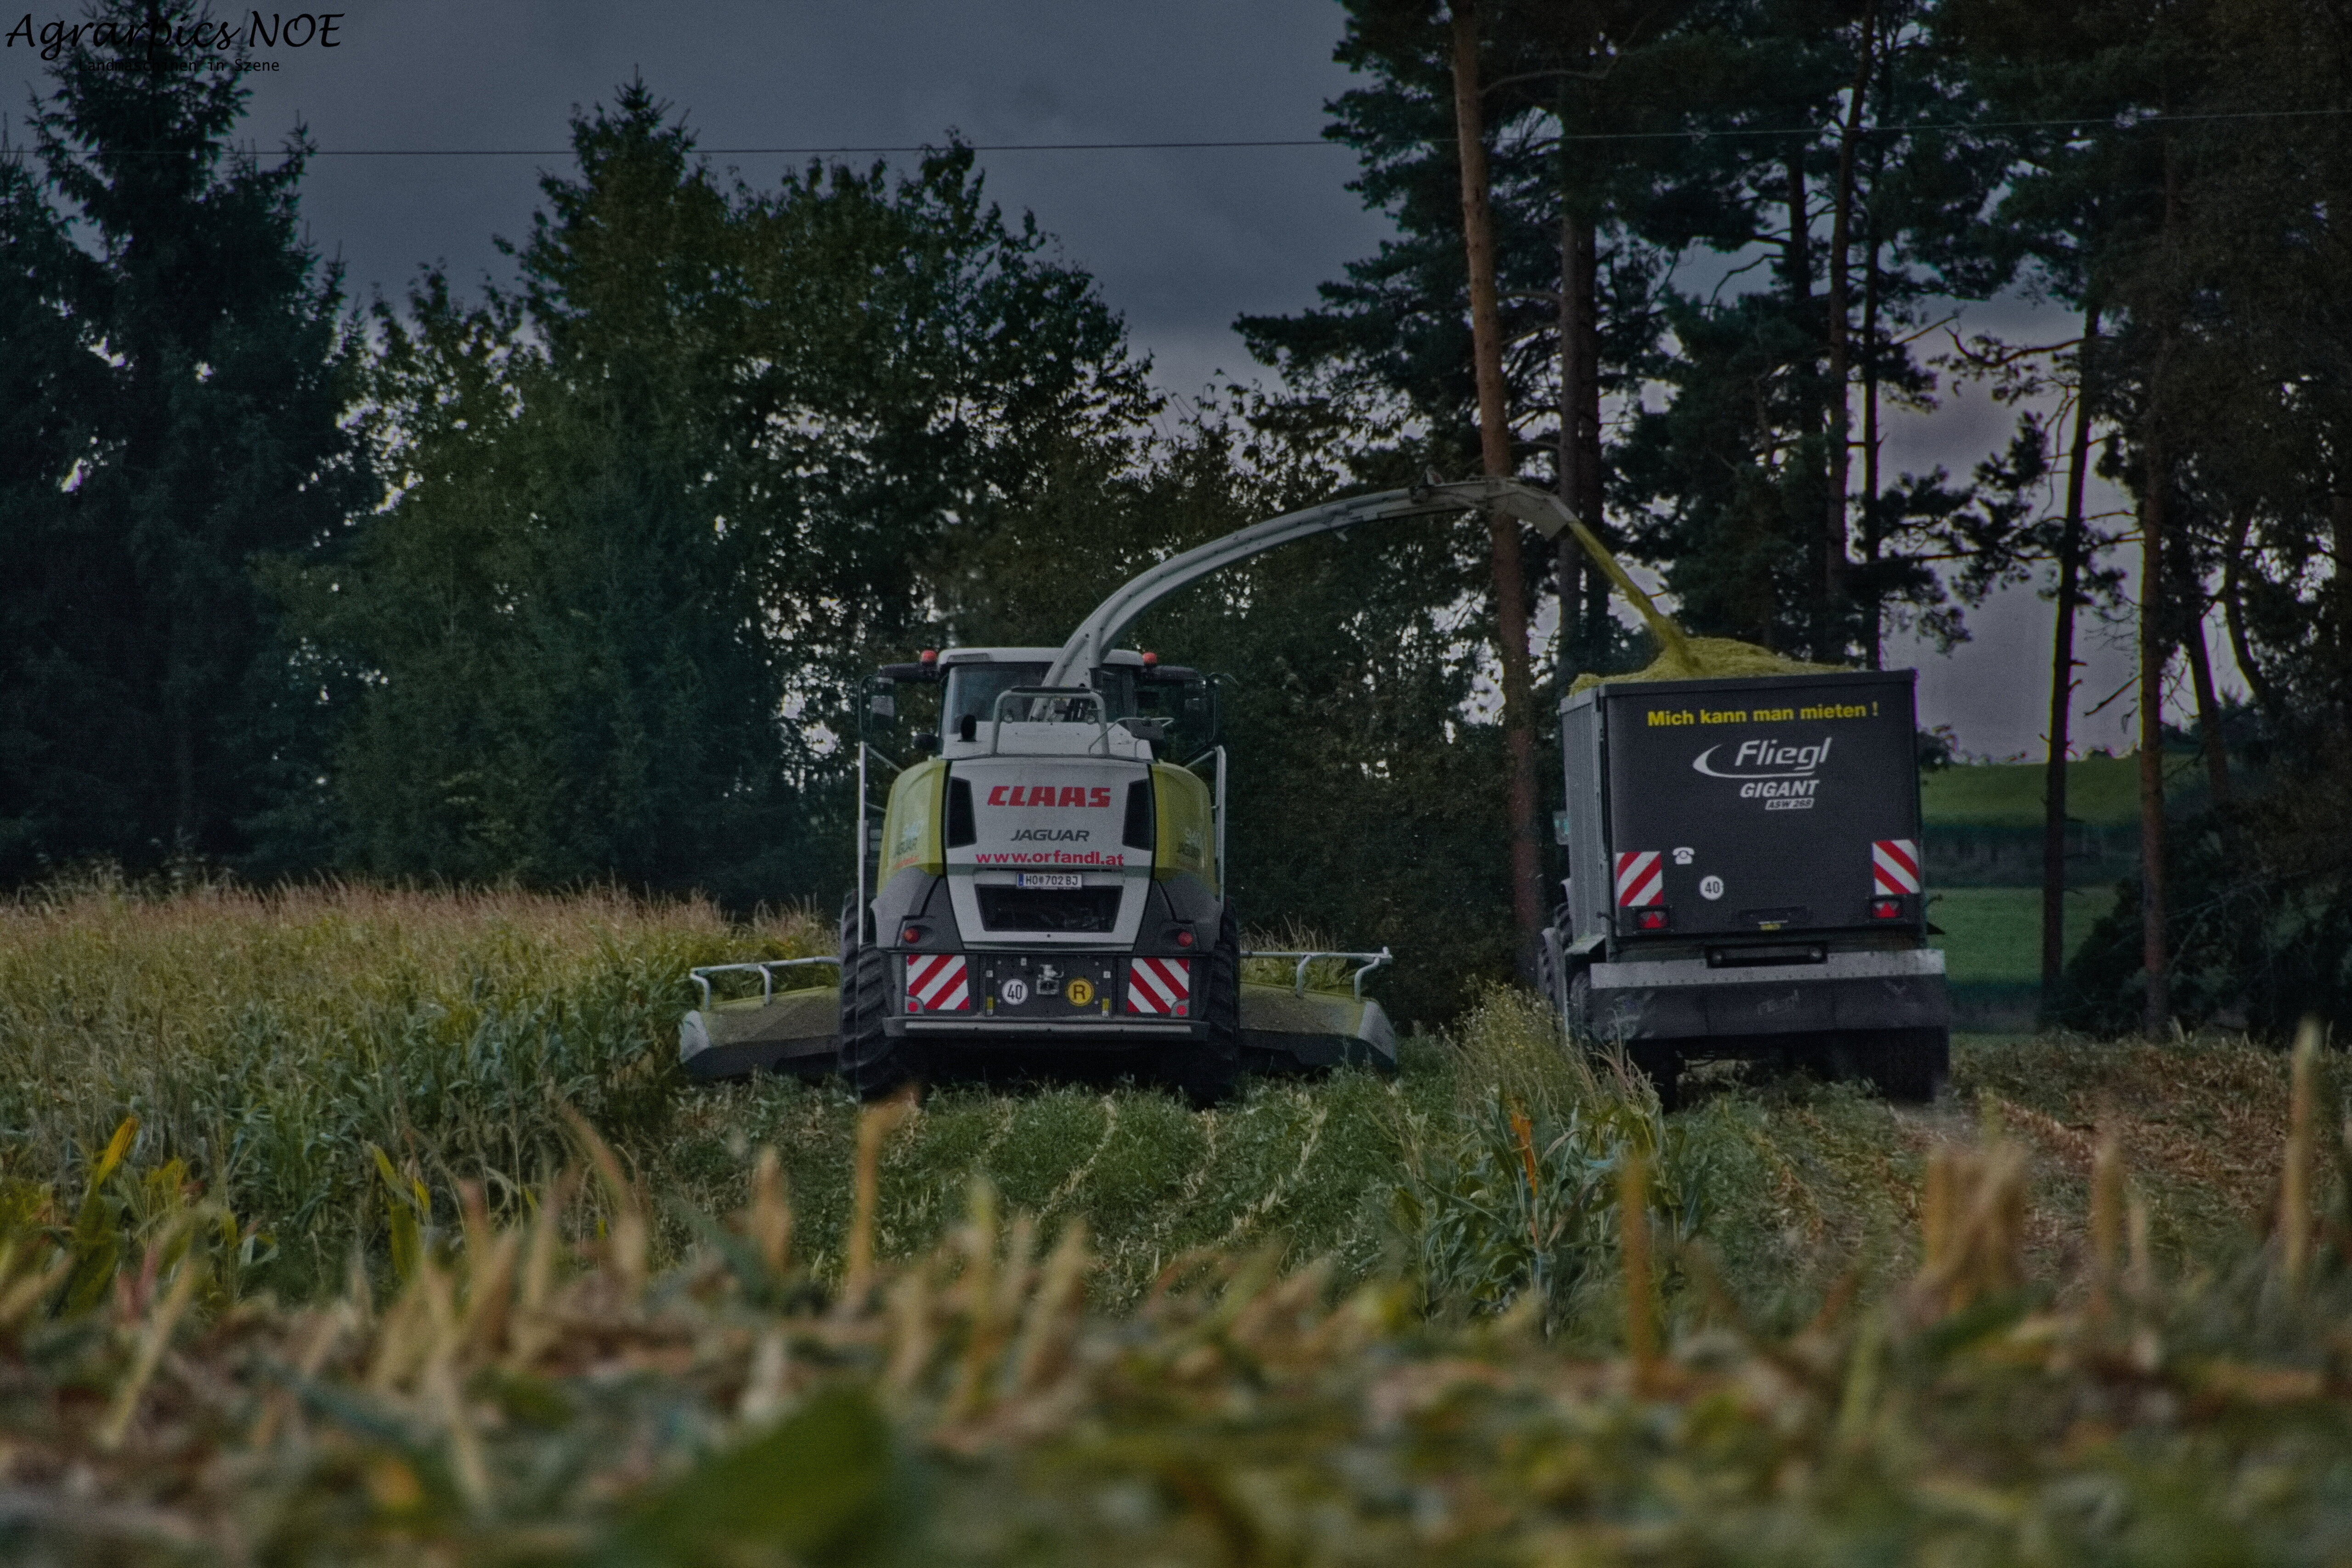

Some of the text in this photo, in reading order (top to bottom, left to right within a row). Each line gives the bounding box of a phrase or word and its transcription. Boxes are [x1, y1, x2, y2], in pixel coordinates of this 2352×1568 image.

[1647, 710, 1695, 726] Mich
[1699, 708, 1747, 725] kann
[1753, 708, 1794, 723] man
[1799, 703, 1867, 720] mieten
[1735, 736, 1832, 770] Fliegl
[988, 786, 1111, 808] CLAAS
[1740, 780, 1820, 798] GIGANT
[1010, 829, 1090, 842] JAGUAR
[975, 850, 1124, 866] www.orfandl.at
[1026, 875, 1078, 885] HO 702 BJ
[1705, 881, 1720, 894] 40
[1007, 984, 1023, 1000] 40
[1073, 984, 1086, 1000] R
